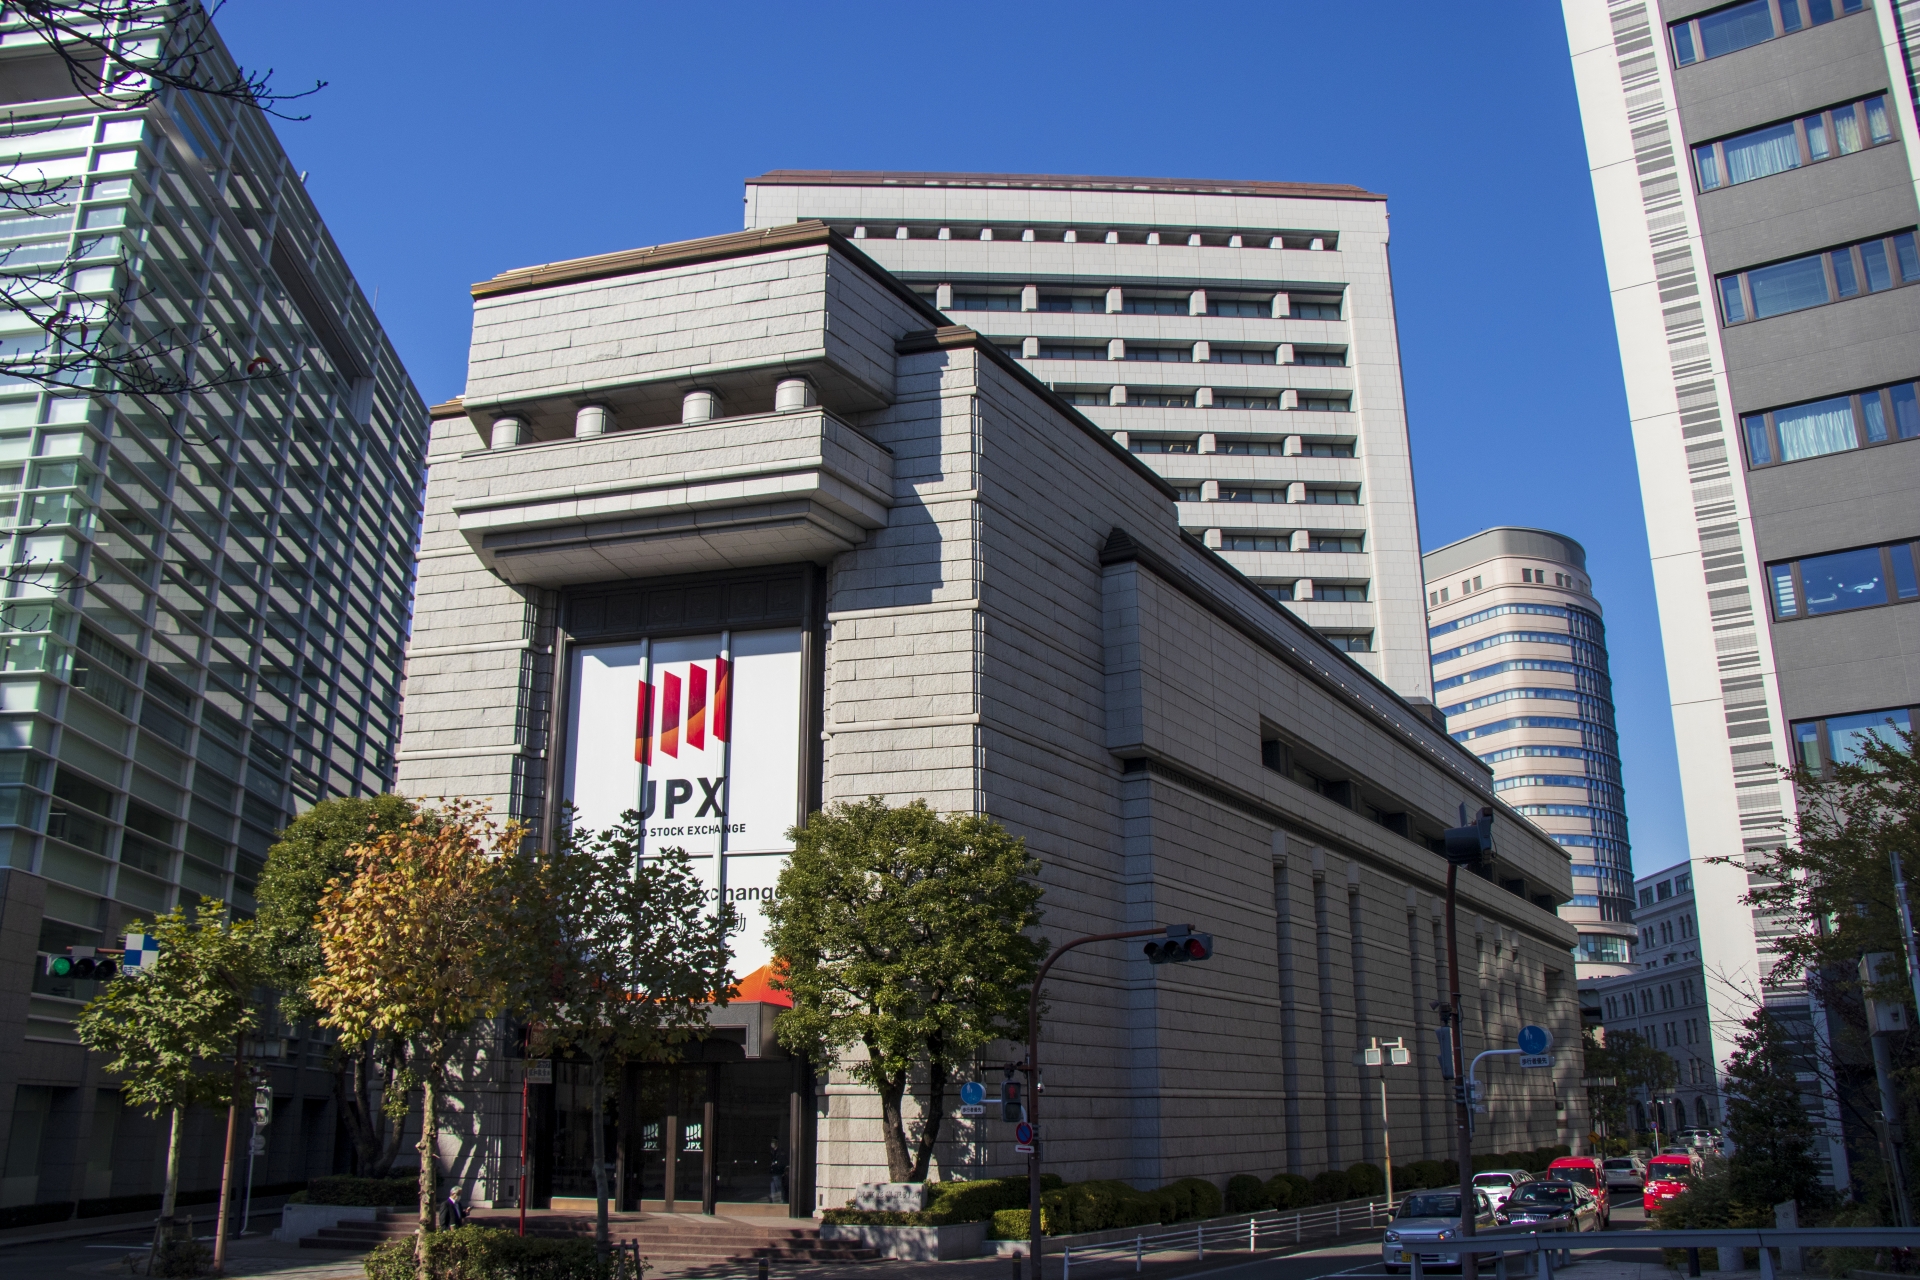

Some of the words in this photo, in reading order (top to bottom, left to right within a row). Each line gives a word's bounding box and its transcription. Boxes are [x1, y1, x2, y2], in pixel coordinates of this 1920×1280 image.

[631, 776, 728, 820] JPX
[613, 828, 647, 838] TOO
[650, 826, 684, 837] STOCK
[687, 823, 746, 836] EXCHANGE
[643, 1141, 658, 1149] JPX
[685, 1141, 701, 1150] JPX
